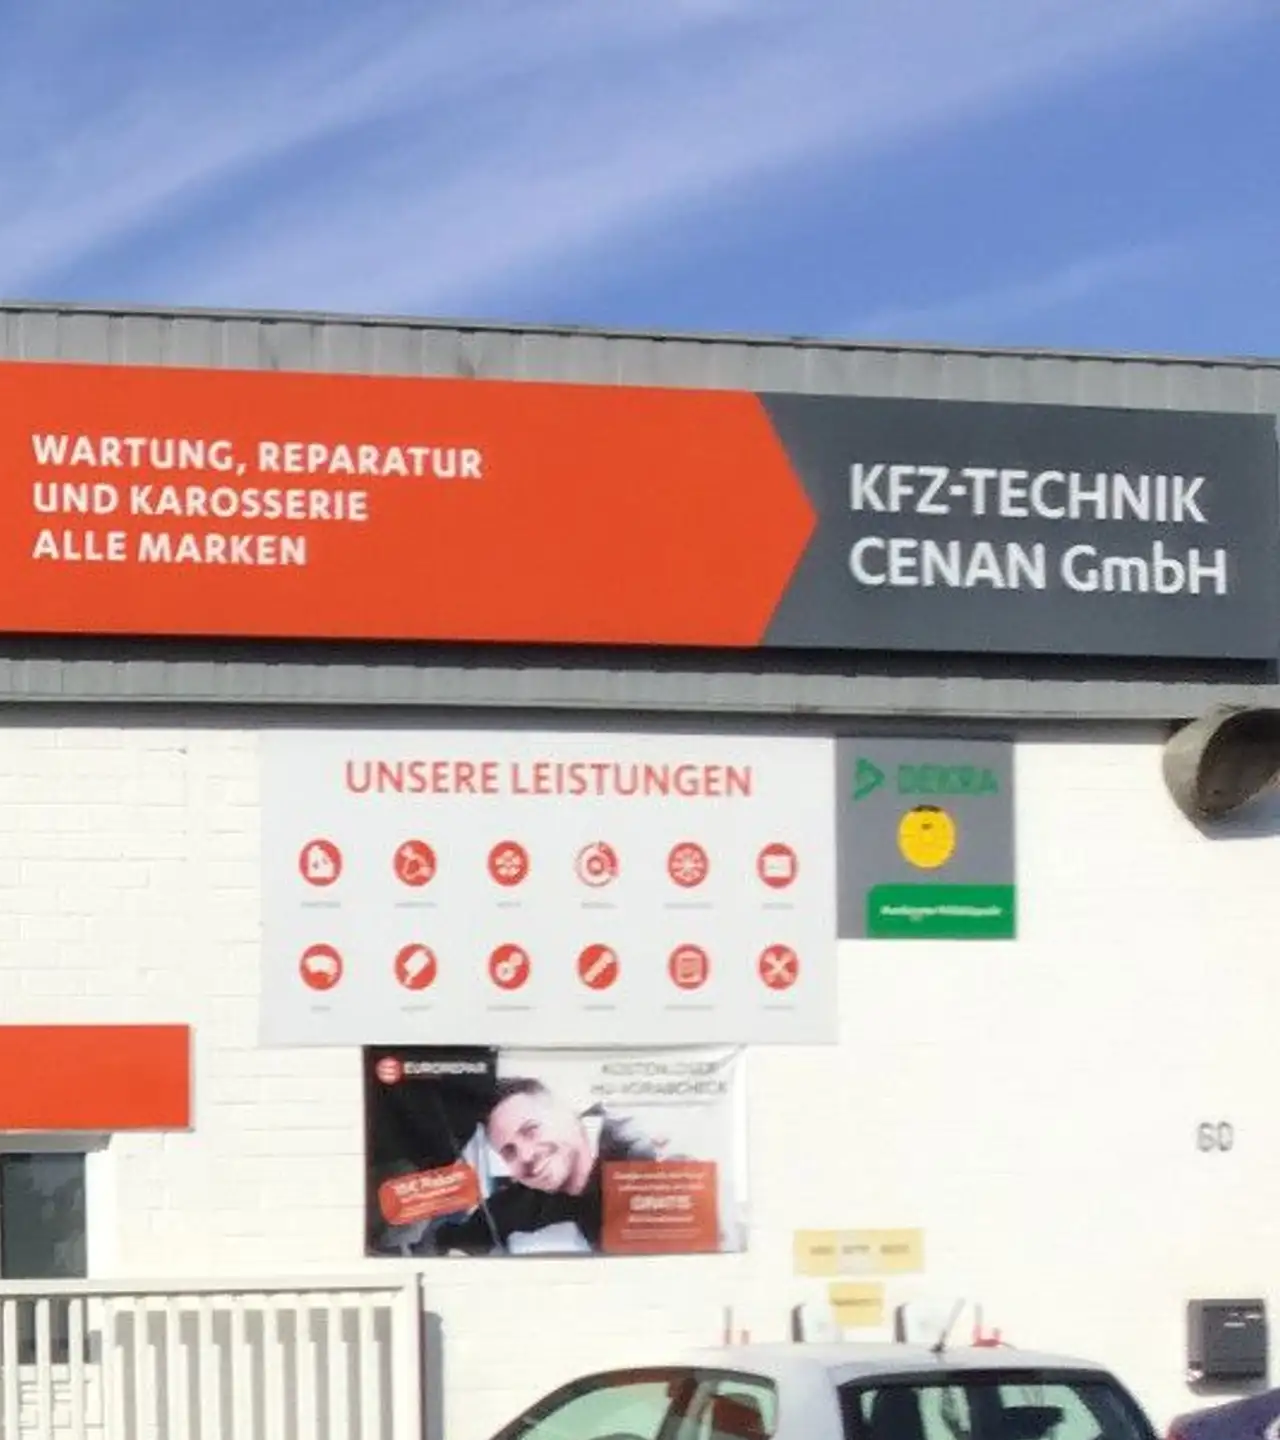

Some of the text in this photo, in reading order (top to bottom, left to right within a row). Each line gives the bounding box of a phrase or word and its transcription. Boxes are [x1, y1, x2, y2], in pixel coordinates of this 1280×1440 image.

[32, 434, 482, 478] WARTUNG, REPARATUR
[33, 483, 367, 521] UND KAROSSERIE
[851, 463, 1207, 523] KFZ-TECHNIK
[32, 529, 306, 565] ALLE MARKEN
[849, 536, 1227, 596] CENAN GmbH
[346, 760, 752, 797] UNSERE LEISTUNGEN
[898, 763, 999, 795] DEKRA
